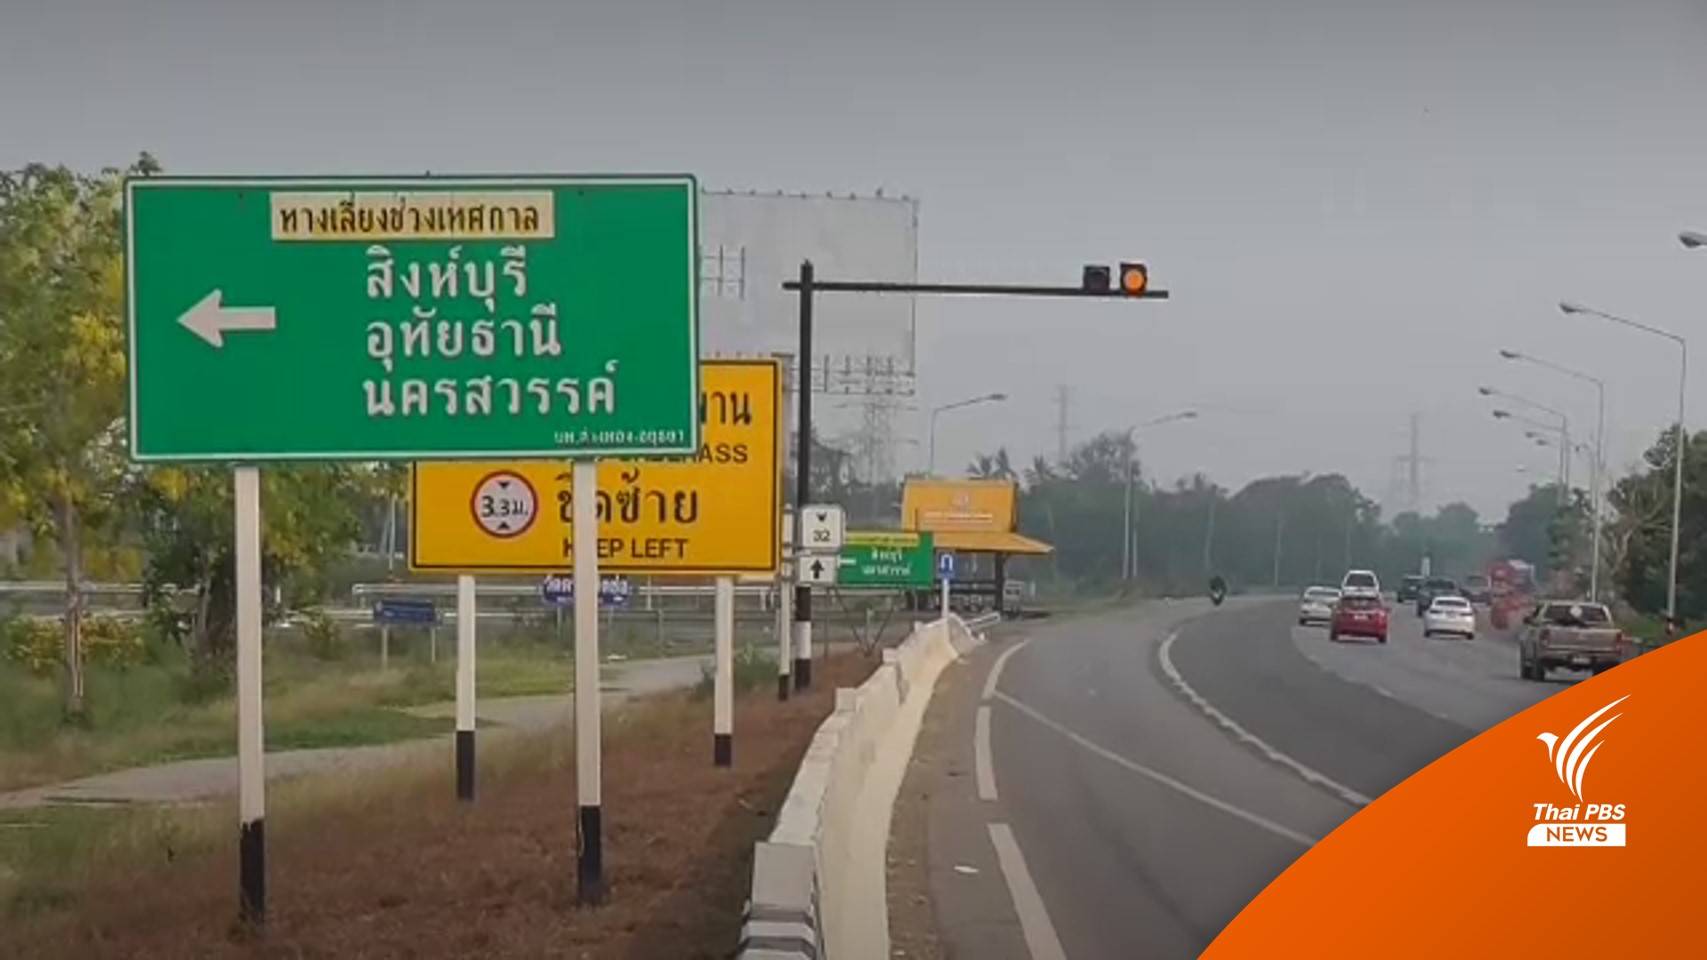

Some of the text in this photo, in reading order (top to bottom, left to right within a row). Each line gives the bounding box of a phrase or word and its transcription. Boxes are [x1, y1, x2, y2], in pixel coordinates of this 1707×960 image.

[279, 195, 540, 234] ทางเลี่ยงช่วงเทศกาล
[365, 244, 528, 312] สิงห์บุรี
[365, 303, 562, 371] อุทัยธานี
[362, 359, 619, 417] นครสวรรค์
[631, 539, 689, 558] LEFT
[813, 529, 831, 542] 32
